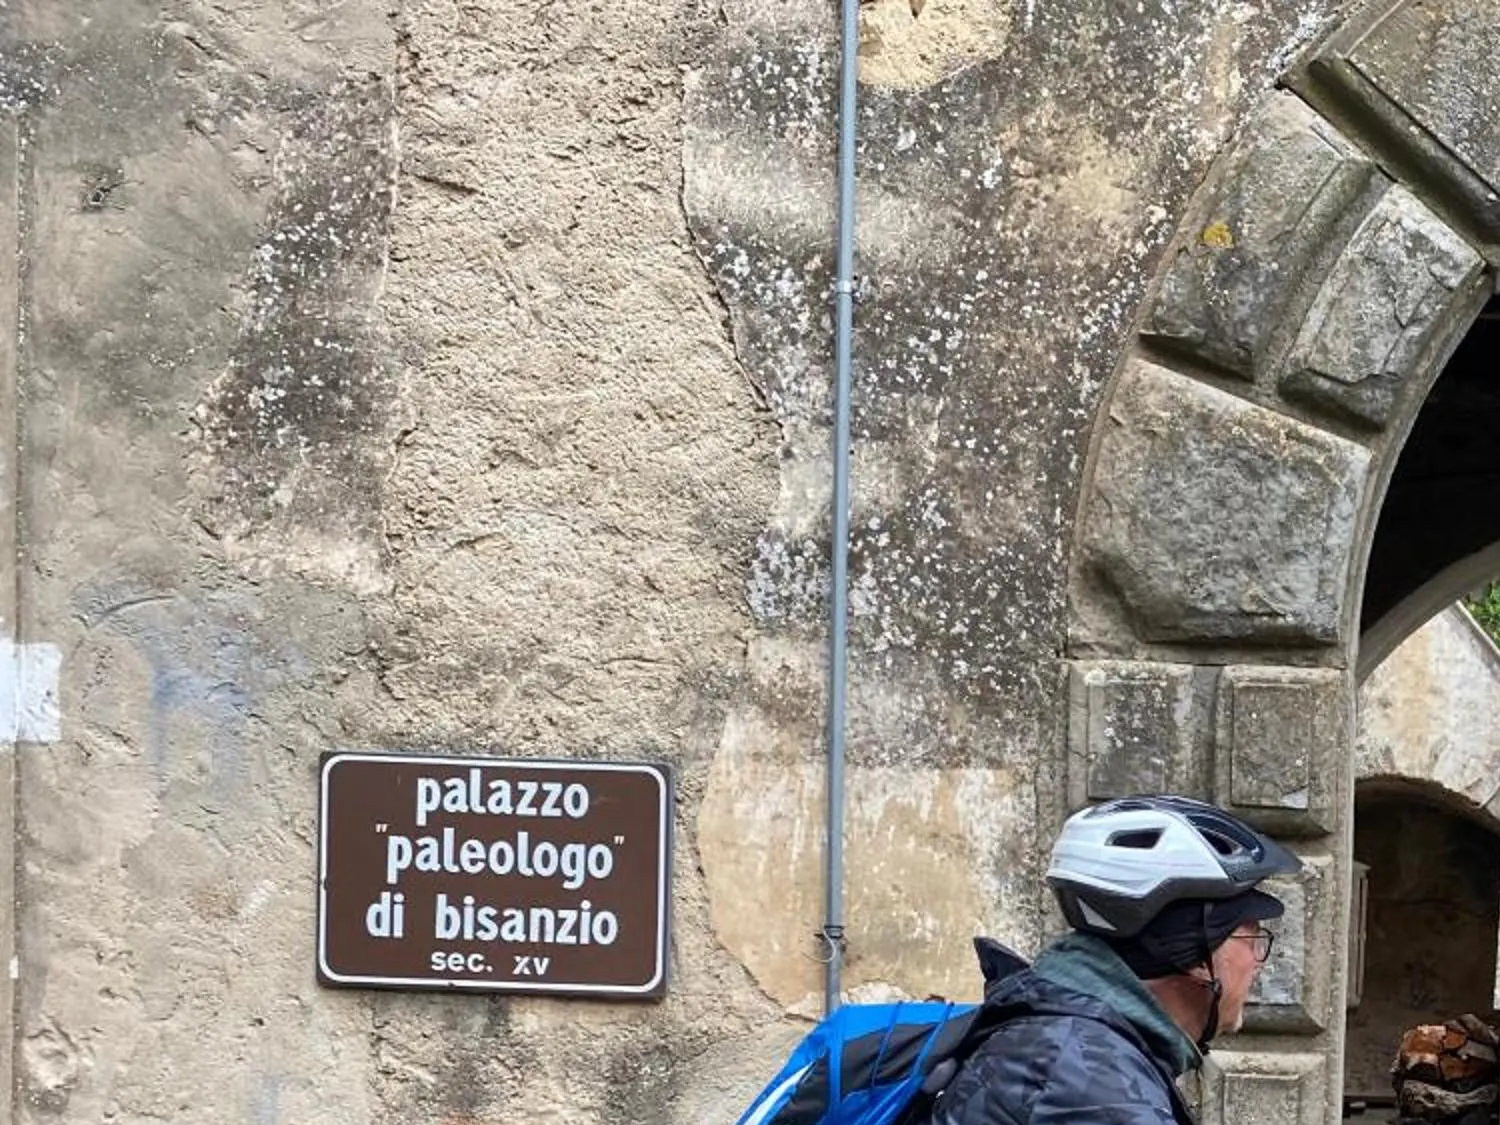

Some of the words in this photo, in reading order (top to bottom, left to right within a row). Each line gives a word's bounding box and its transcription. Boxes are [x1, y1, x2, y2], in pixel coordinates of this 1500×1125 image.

[416, 768, 589, 826] palazzo
[376, 824, 625, 889] "paleologo"
[366, 892, 404, 938] di
[435, 894, 618, 945] bisanzio
[431, 951, 493, 973] sec.
